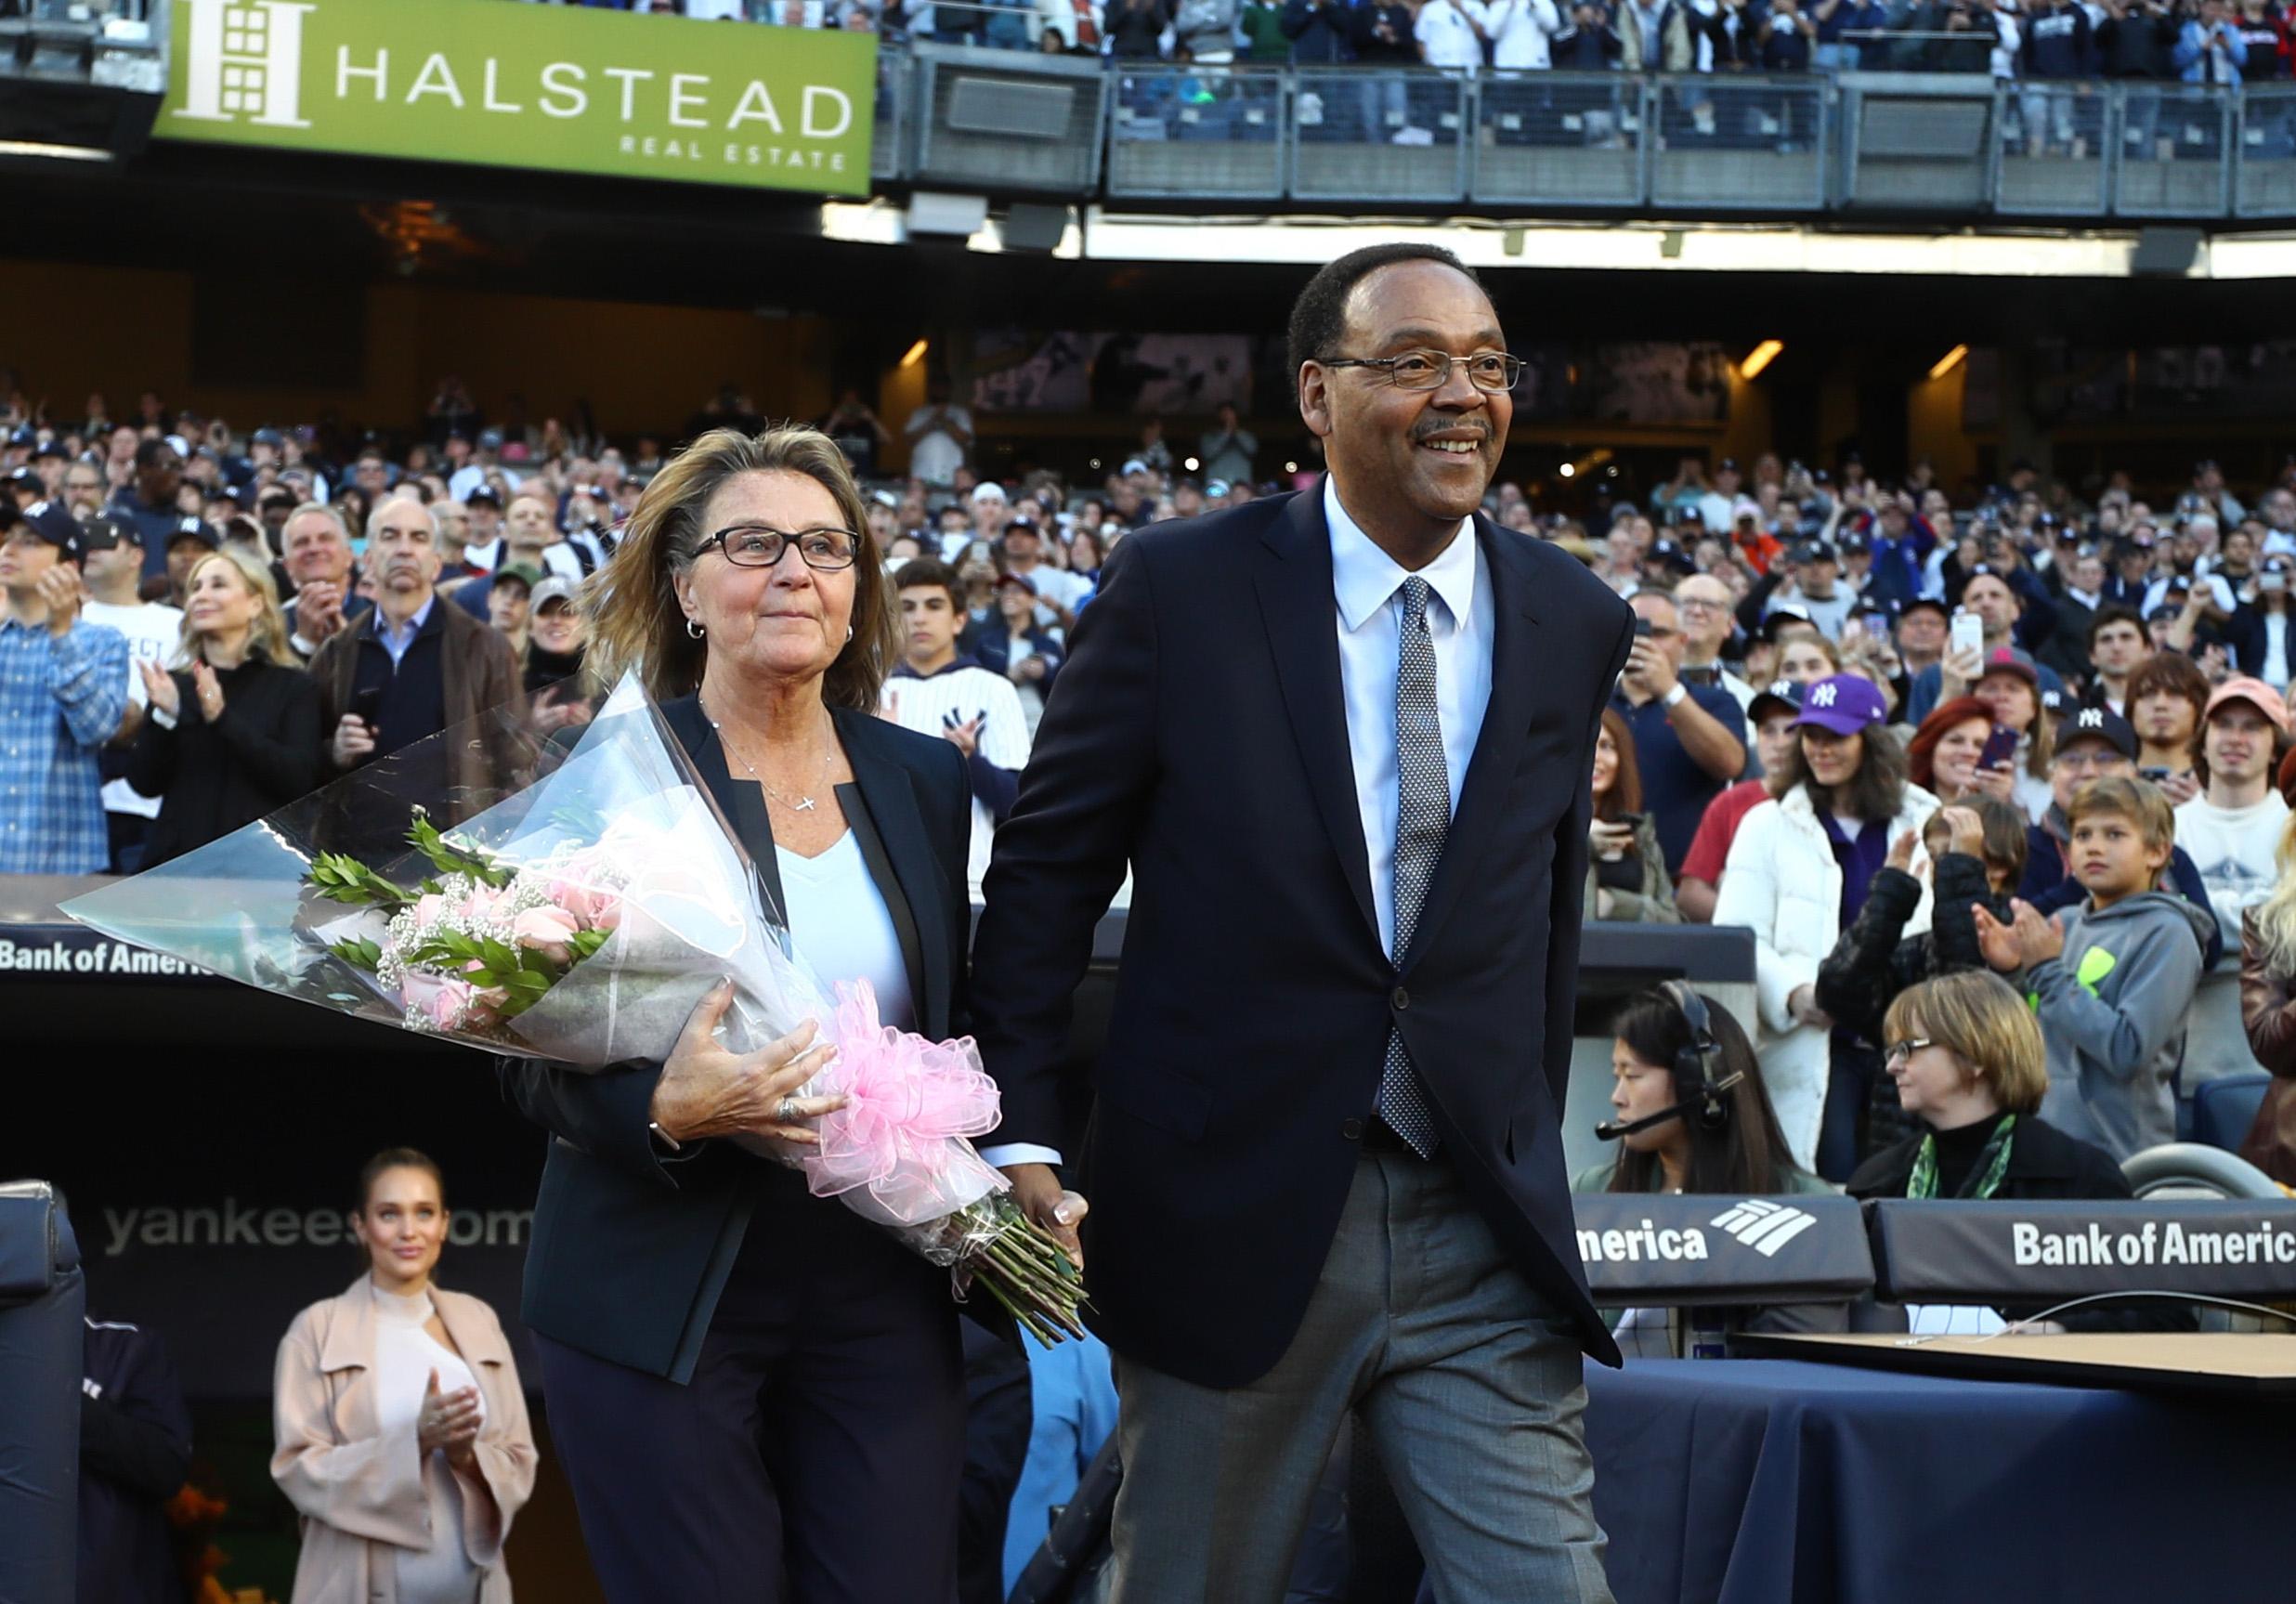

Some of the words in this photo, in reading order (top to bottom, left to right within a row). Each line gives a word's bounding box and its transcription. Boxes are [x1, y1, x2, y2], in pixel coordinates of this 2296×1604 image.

[335, 45, 853, 138] HALSTEAD
[620, 136, 702, 162] REAL
[724, 143, 846, 174] ESTATE
[0, 940, 72, 972] Bank
[74, 942, 108, 972] of
[1576, 1218, 1709, 1262] merica
[2012, 1221, 2114, 1266] Bank
[2117, 1221, 2159, 1265] of
[2161, 1219, 2296, 1265] Americ
